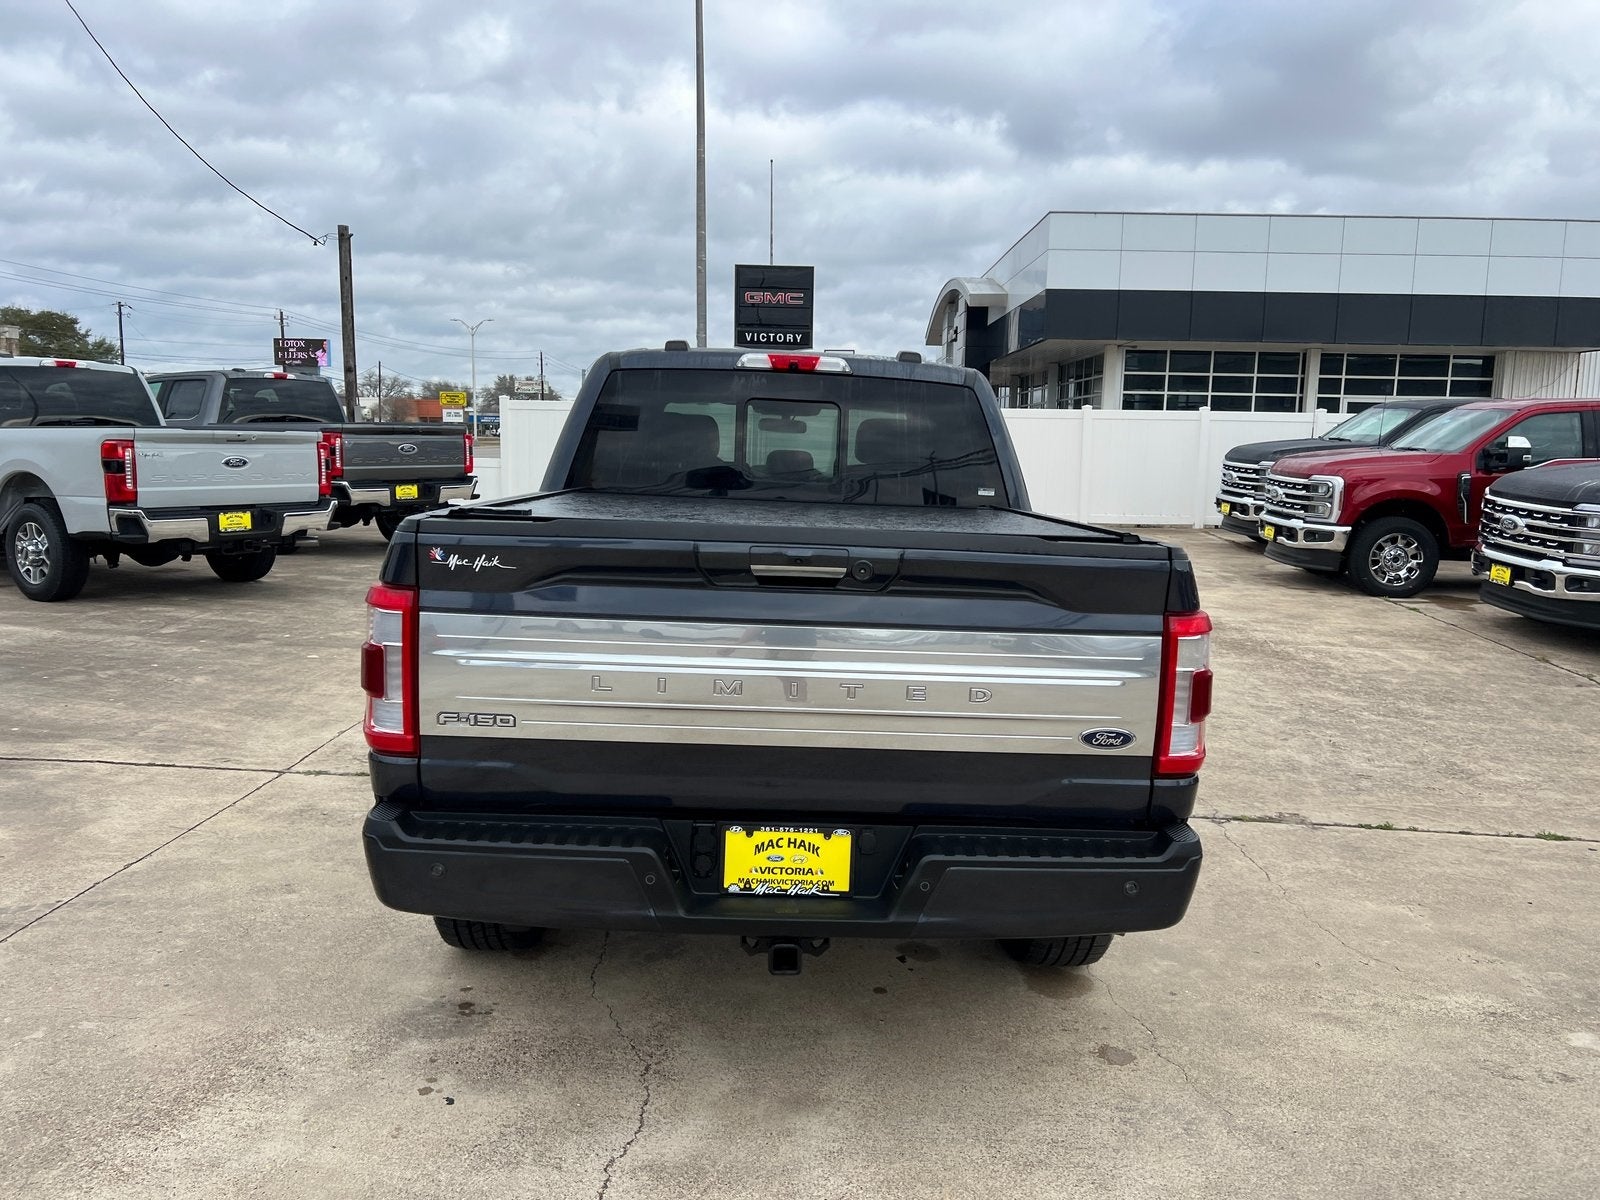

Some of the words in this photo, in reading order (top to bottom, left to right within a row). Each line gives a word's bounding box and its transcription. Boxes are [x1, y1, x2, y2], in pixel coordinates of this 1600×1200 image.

[744, 291, 804, 305] GMC
[745, 332, 802, 343] VICTORY
[278, 351, 308, 359] FLLERS
[446, 553, 473, 571] Mac
[473, 553, 510, 572] Haik
[591, 675, 993, 703] LIMITED
[437, 711, 516, 728] F-150
[754, 837, 784, 856] MAC
[787, 837, 821, 858] HAIK
[759, 866, 815, 876] VICTORIA
[753, 882, 787, 896] Mac
[786, 883, 826, 896] Haik
